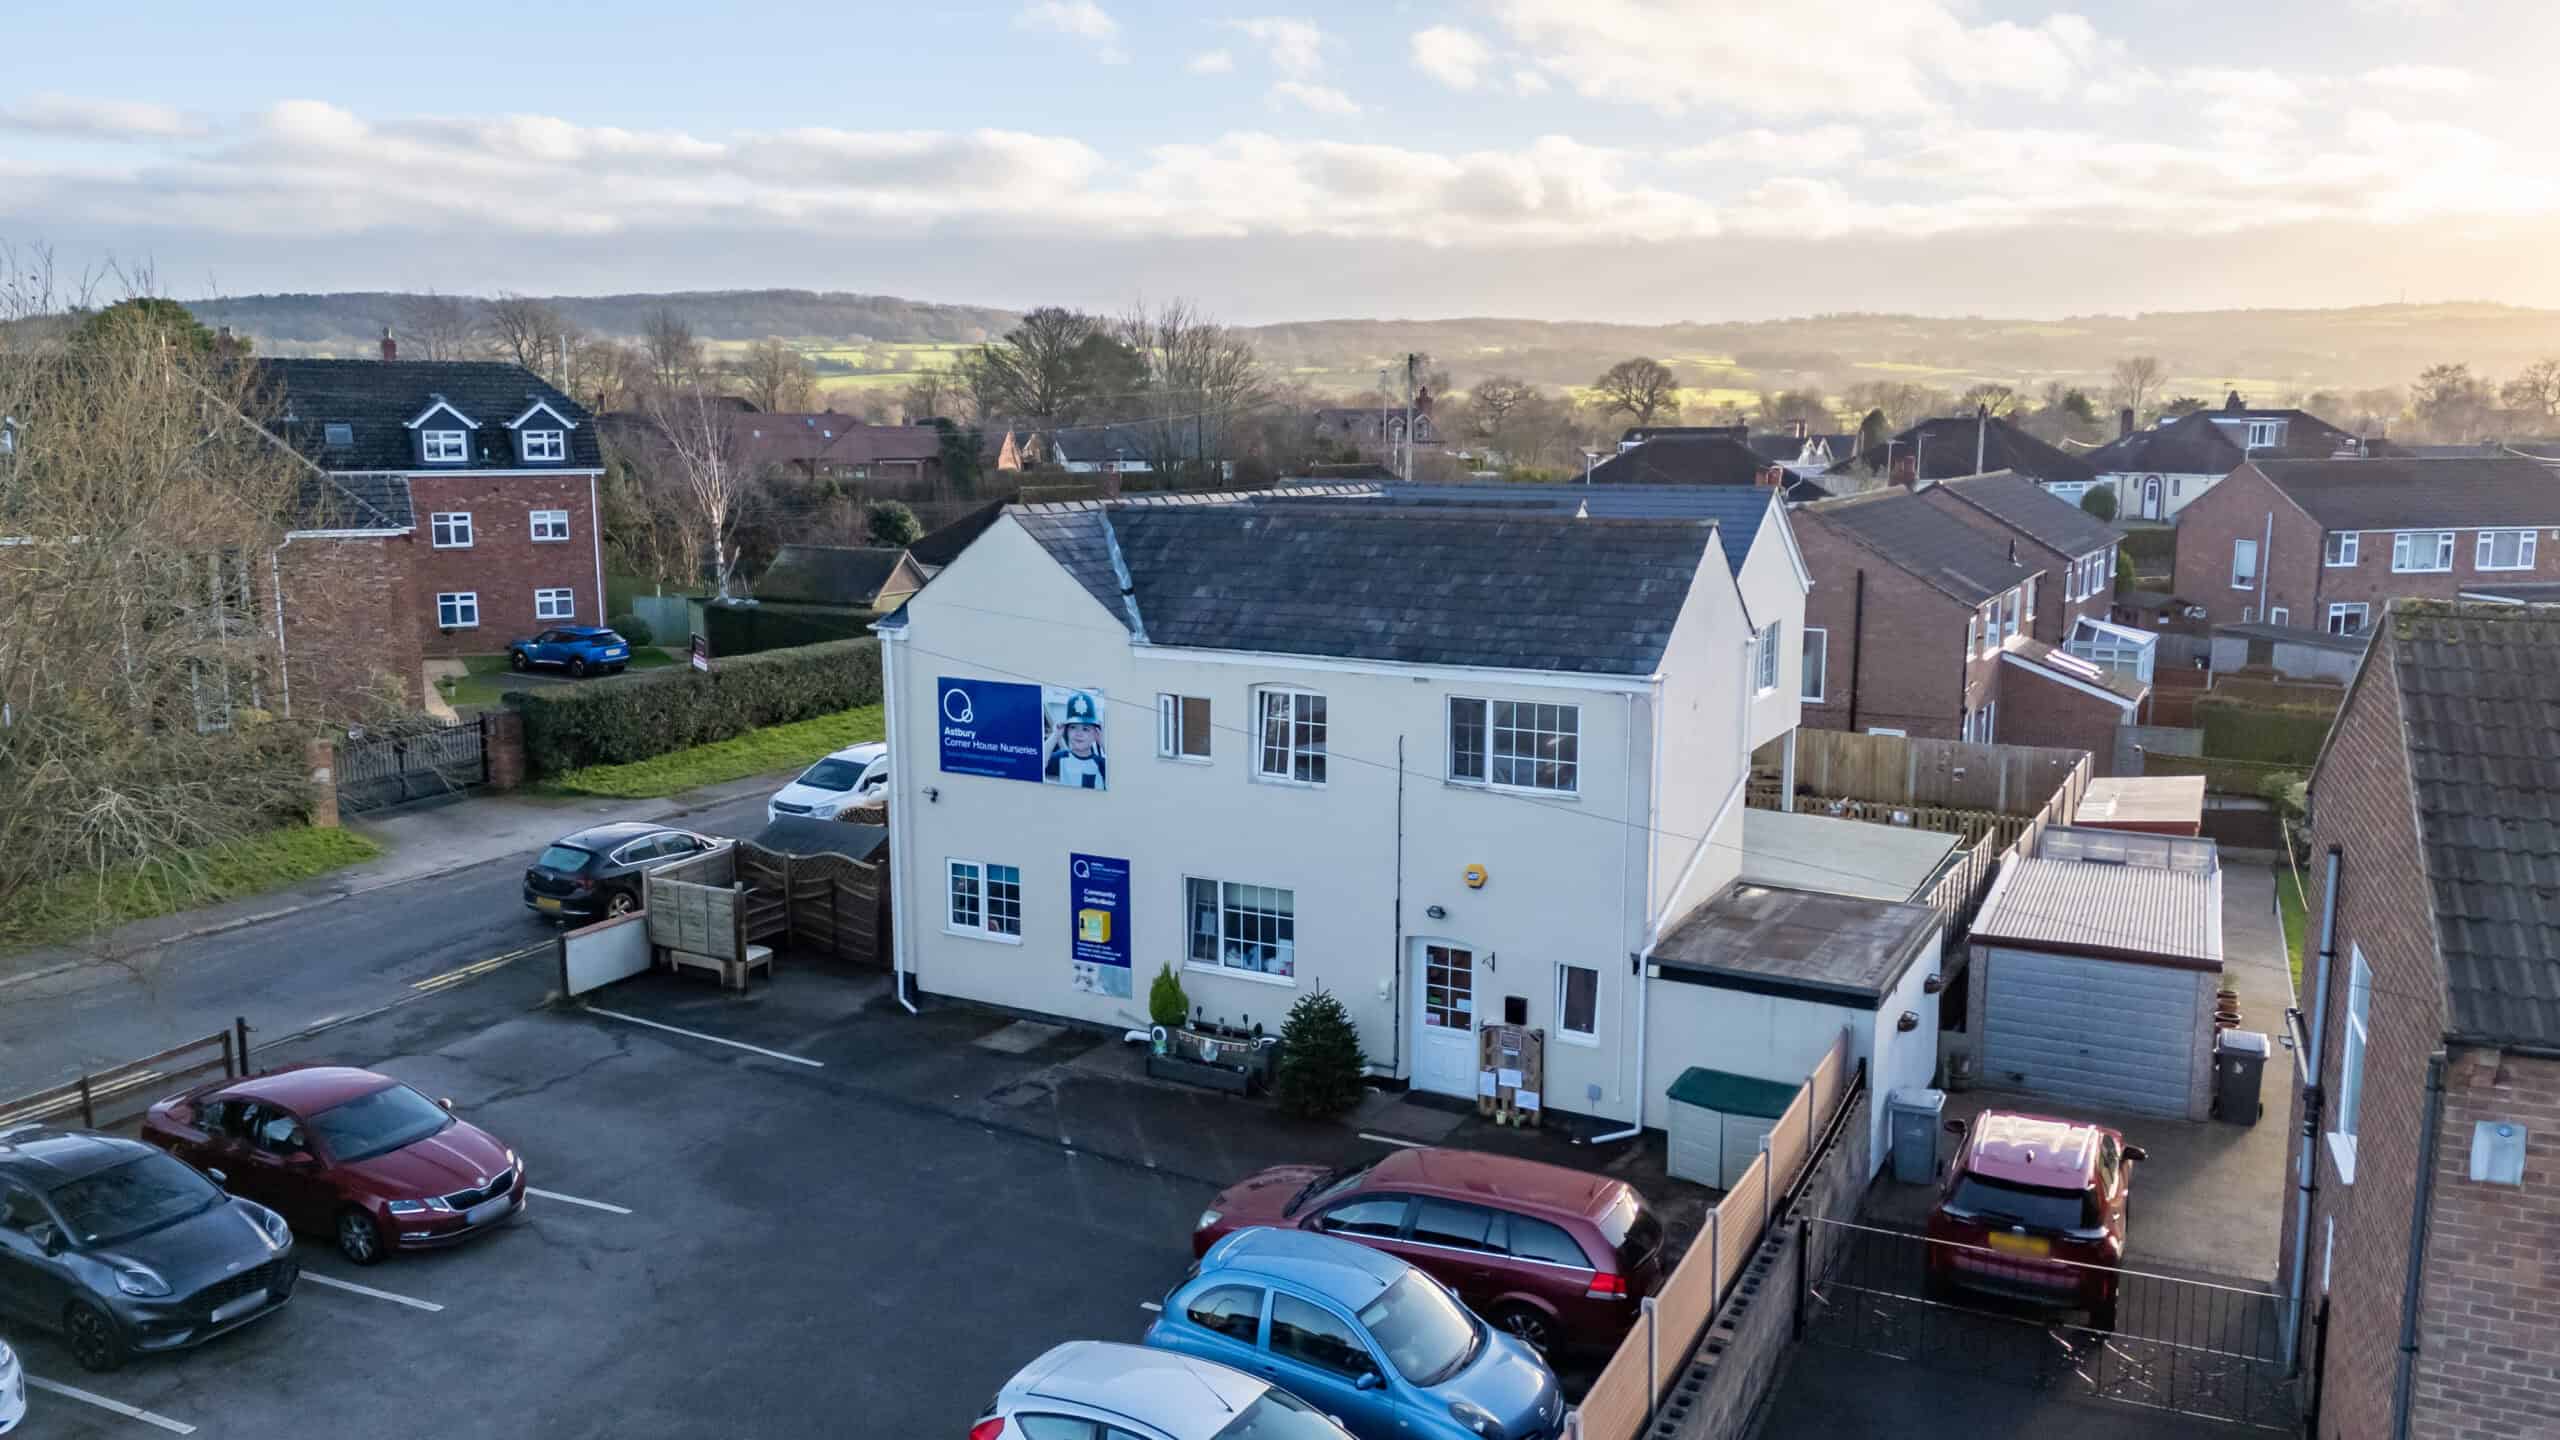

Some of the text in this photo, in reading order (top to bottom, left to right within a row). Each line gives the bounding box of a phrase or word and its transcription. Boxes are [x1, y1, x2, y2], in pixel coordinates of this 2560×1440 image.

[945, 727, 976, 740] Astbury
[945, 737, 1038, 755] Corner House Nurseries
